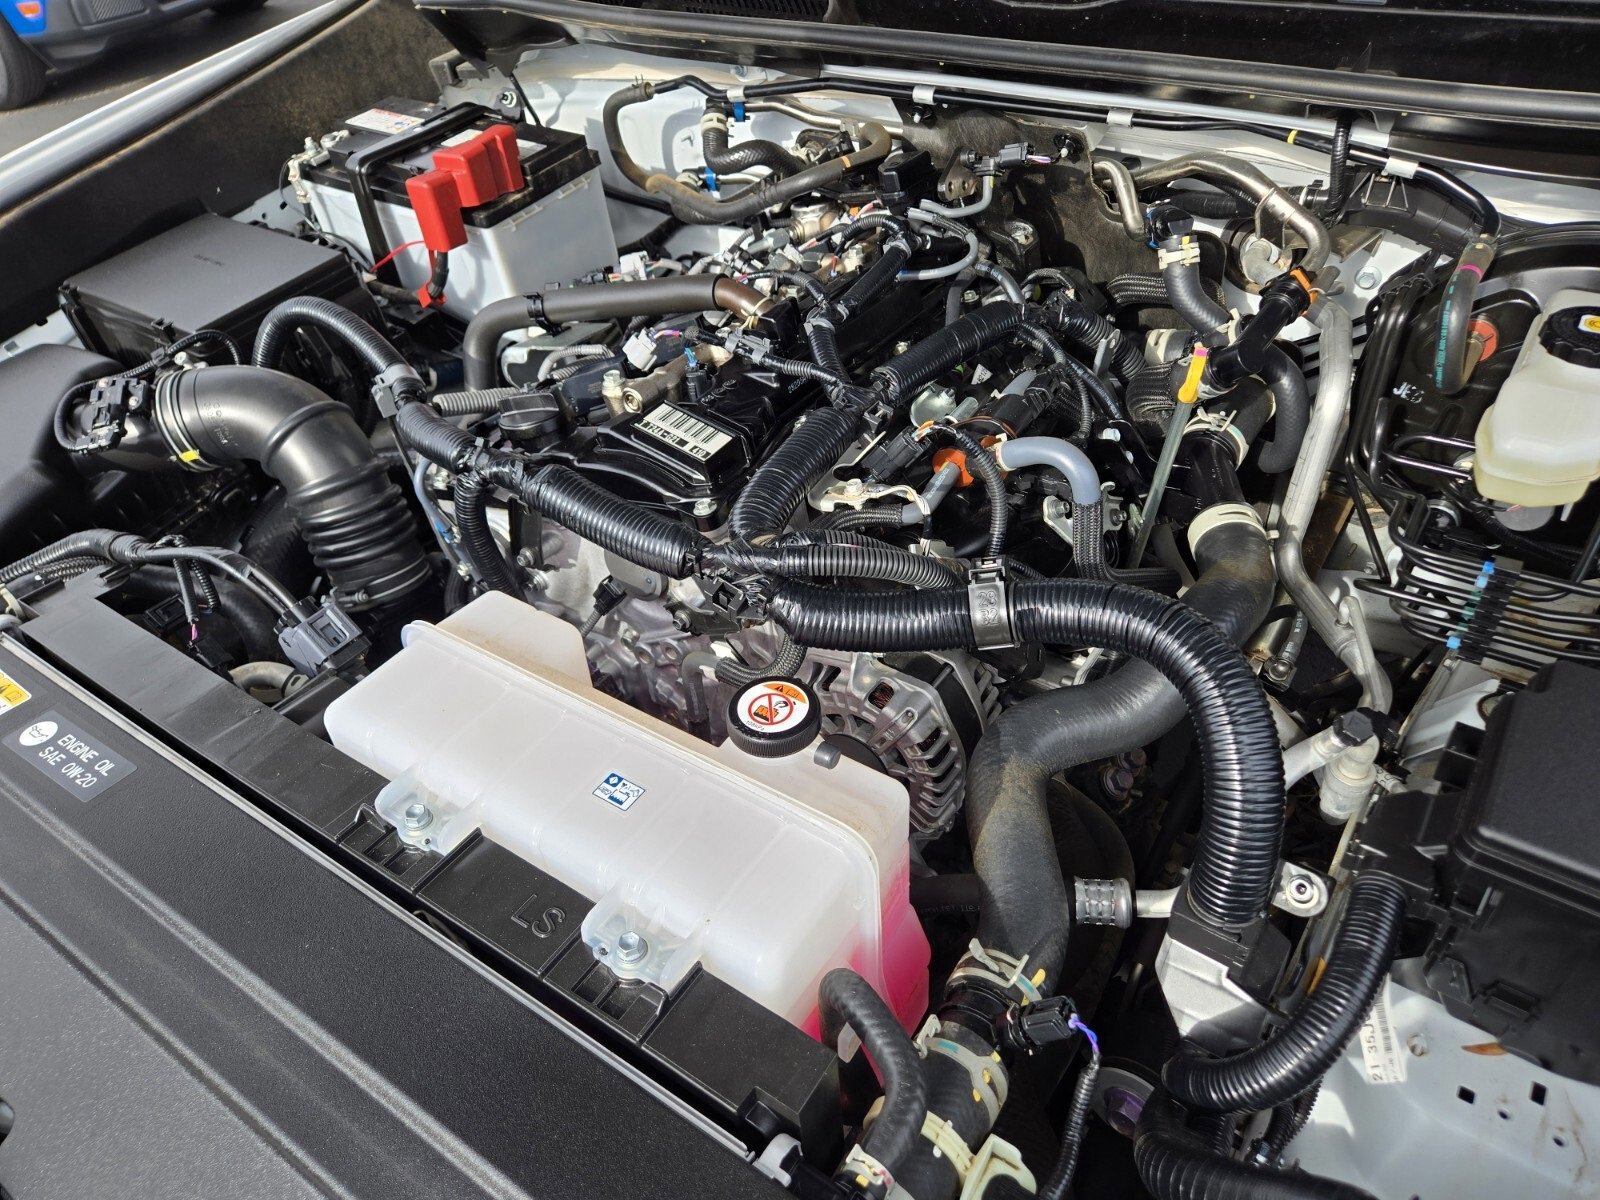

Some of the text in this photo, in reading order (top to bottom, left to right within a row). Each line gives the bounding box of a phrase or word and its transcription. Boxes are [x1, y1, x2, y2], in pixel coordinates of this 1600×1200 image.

[692, 446, 709, 458] 410
[978, 590, 998, 608] 28
[979, 607, 999, 627] 32
[38, 746, 98, 788] SAE 0W-20
[57, 733, 115, 777] ENGINE OIL
[510, 894, 565, 938] LS
